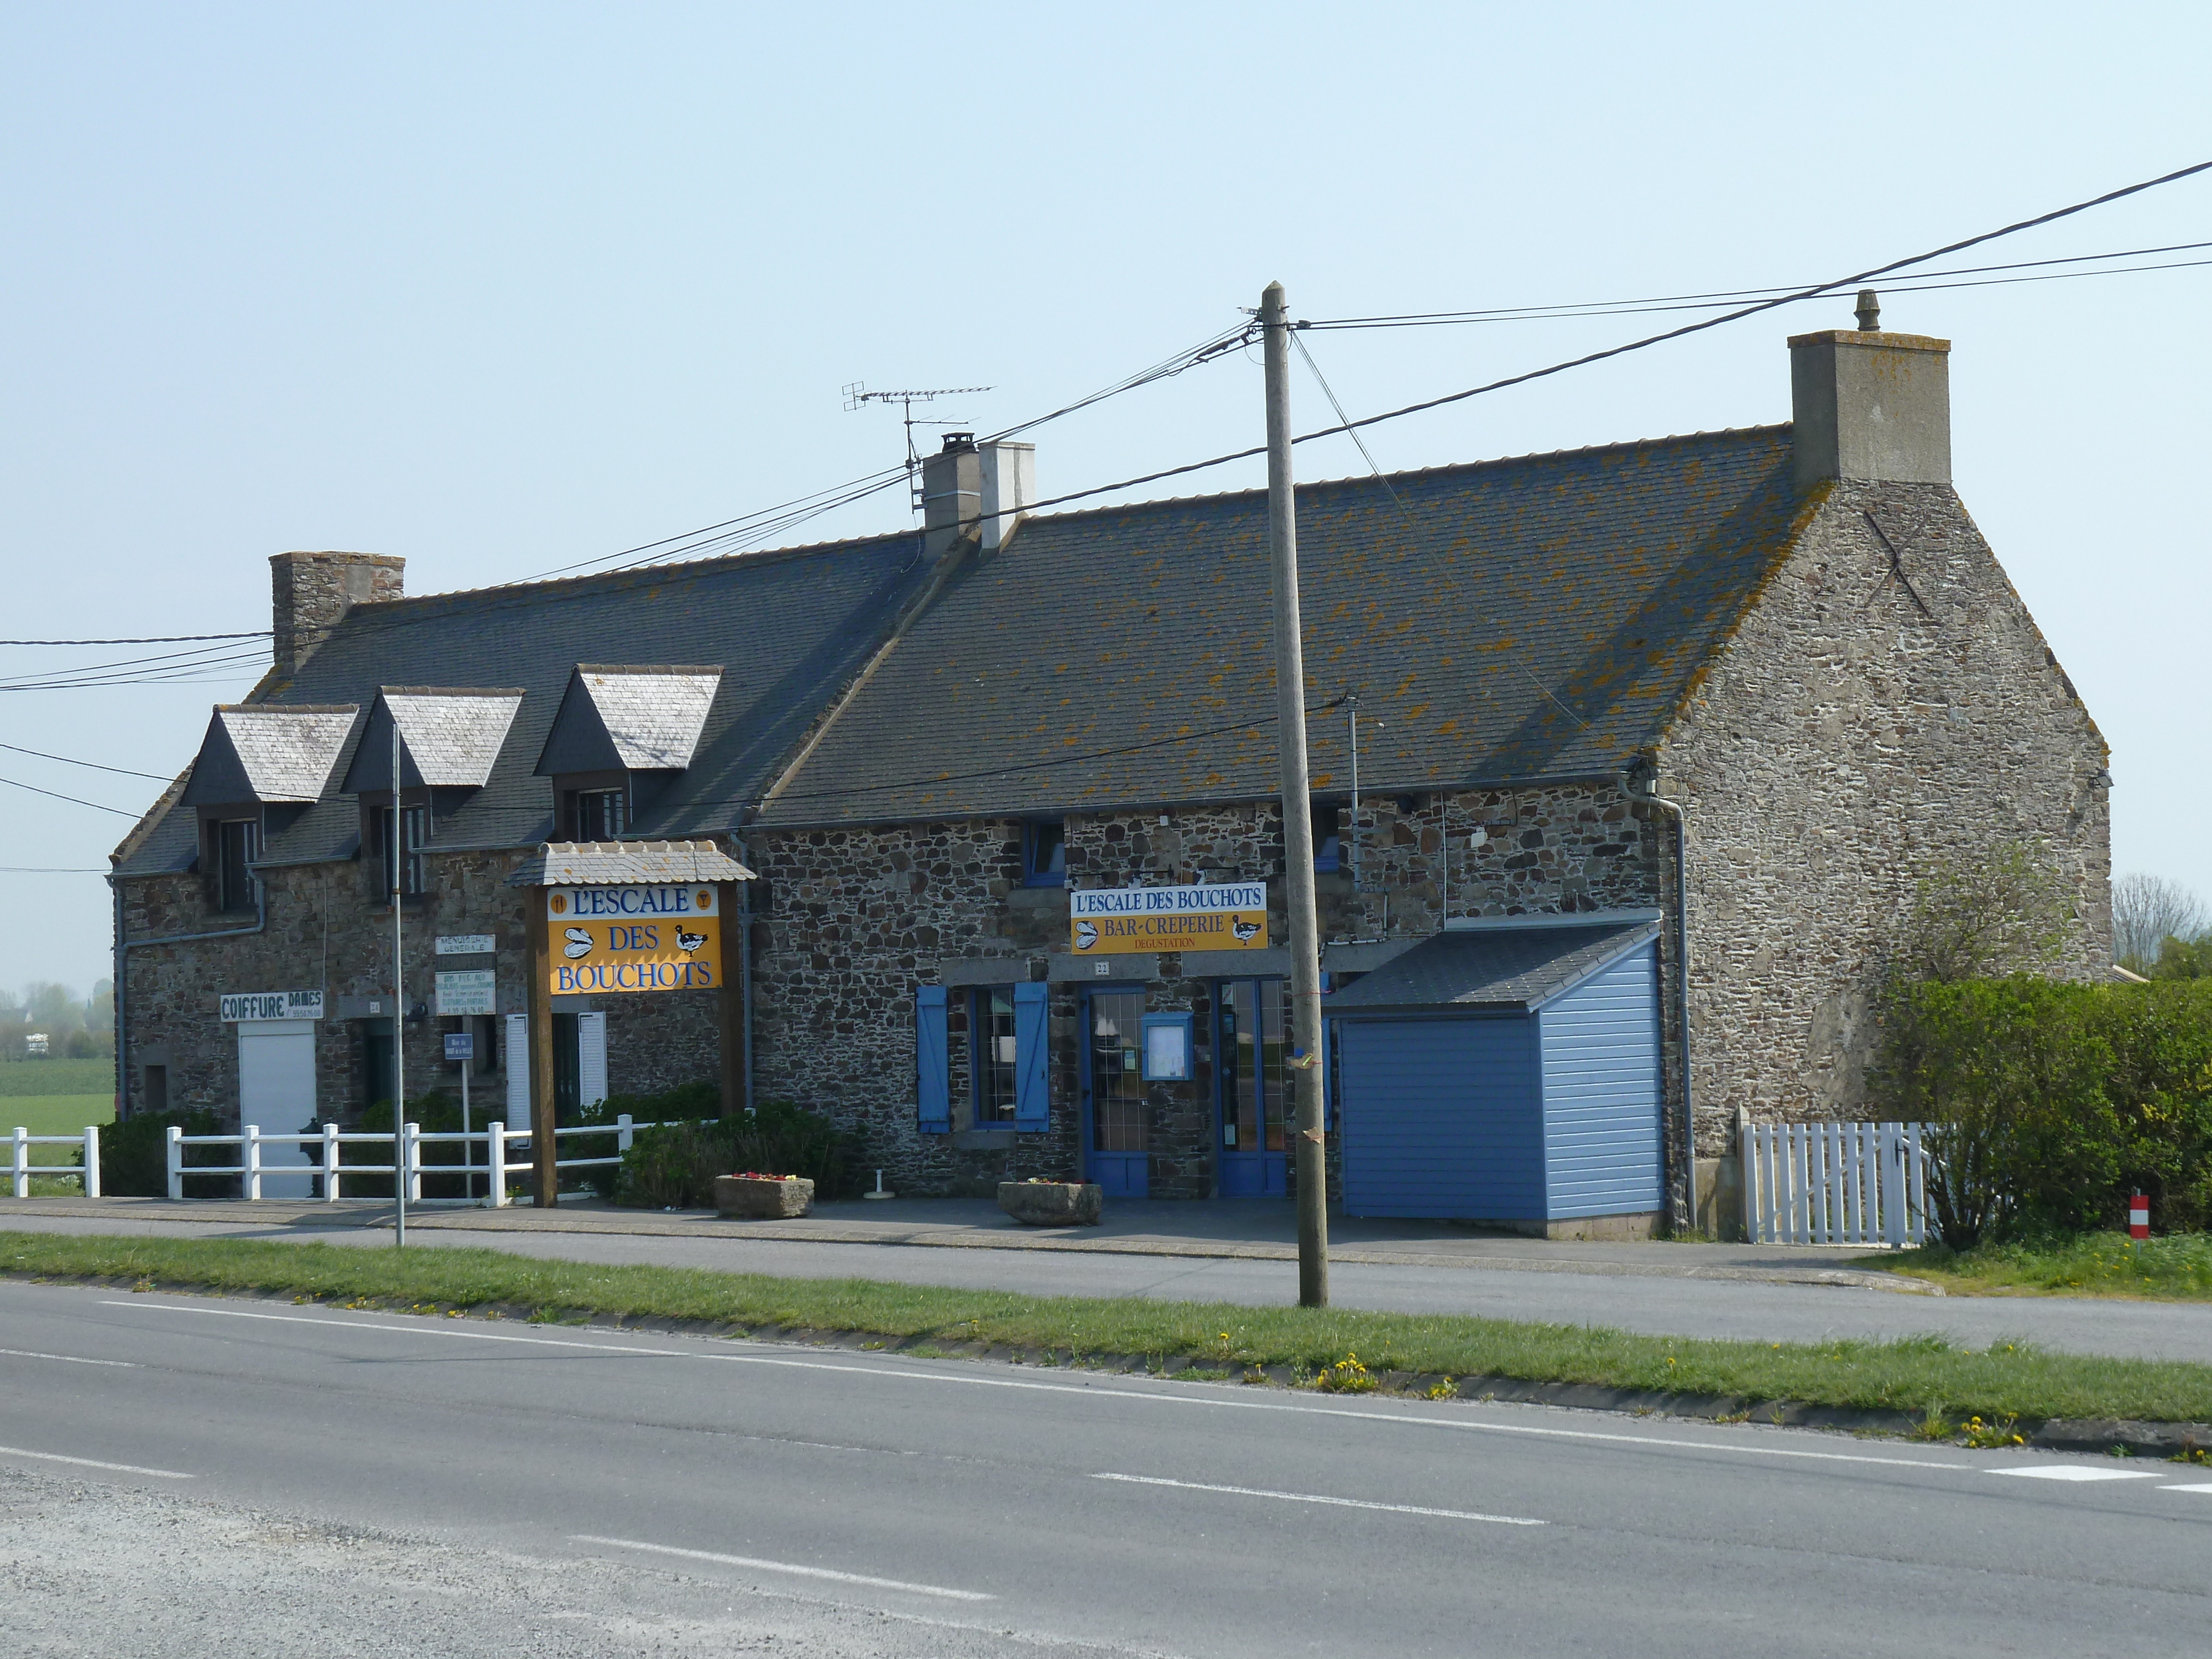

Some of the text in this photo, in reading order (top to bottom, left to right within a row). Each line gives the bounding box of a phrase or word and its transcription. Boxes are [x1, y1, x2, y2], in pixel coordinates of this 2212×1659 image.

[572, 888, 689, 915] L'ESCALE
[1077, 888, 1261, 912] L'ESCALE DES BOUCHOTS
[607, 925, 660, 951] DES
[1135, 937, 1195, 949] DEGUSTATION
[556, 961, 712, 990] BOUCHOTS
[221, 995, 285, 1019] COIFFURE
[288, 991, 321, 1007] DAMES
